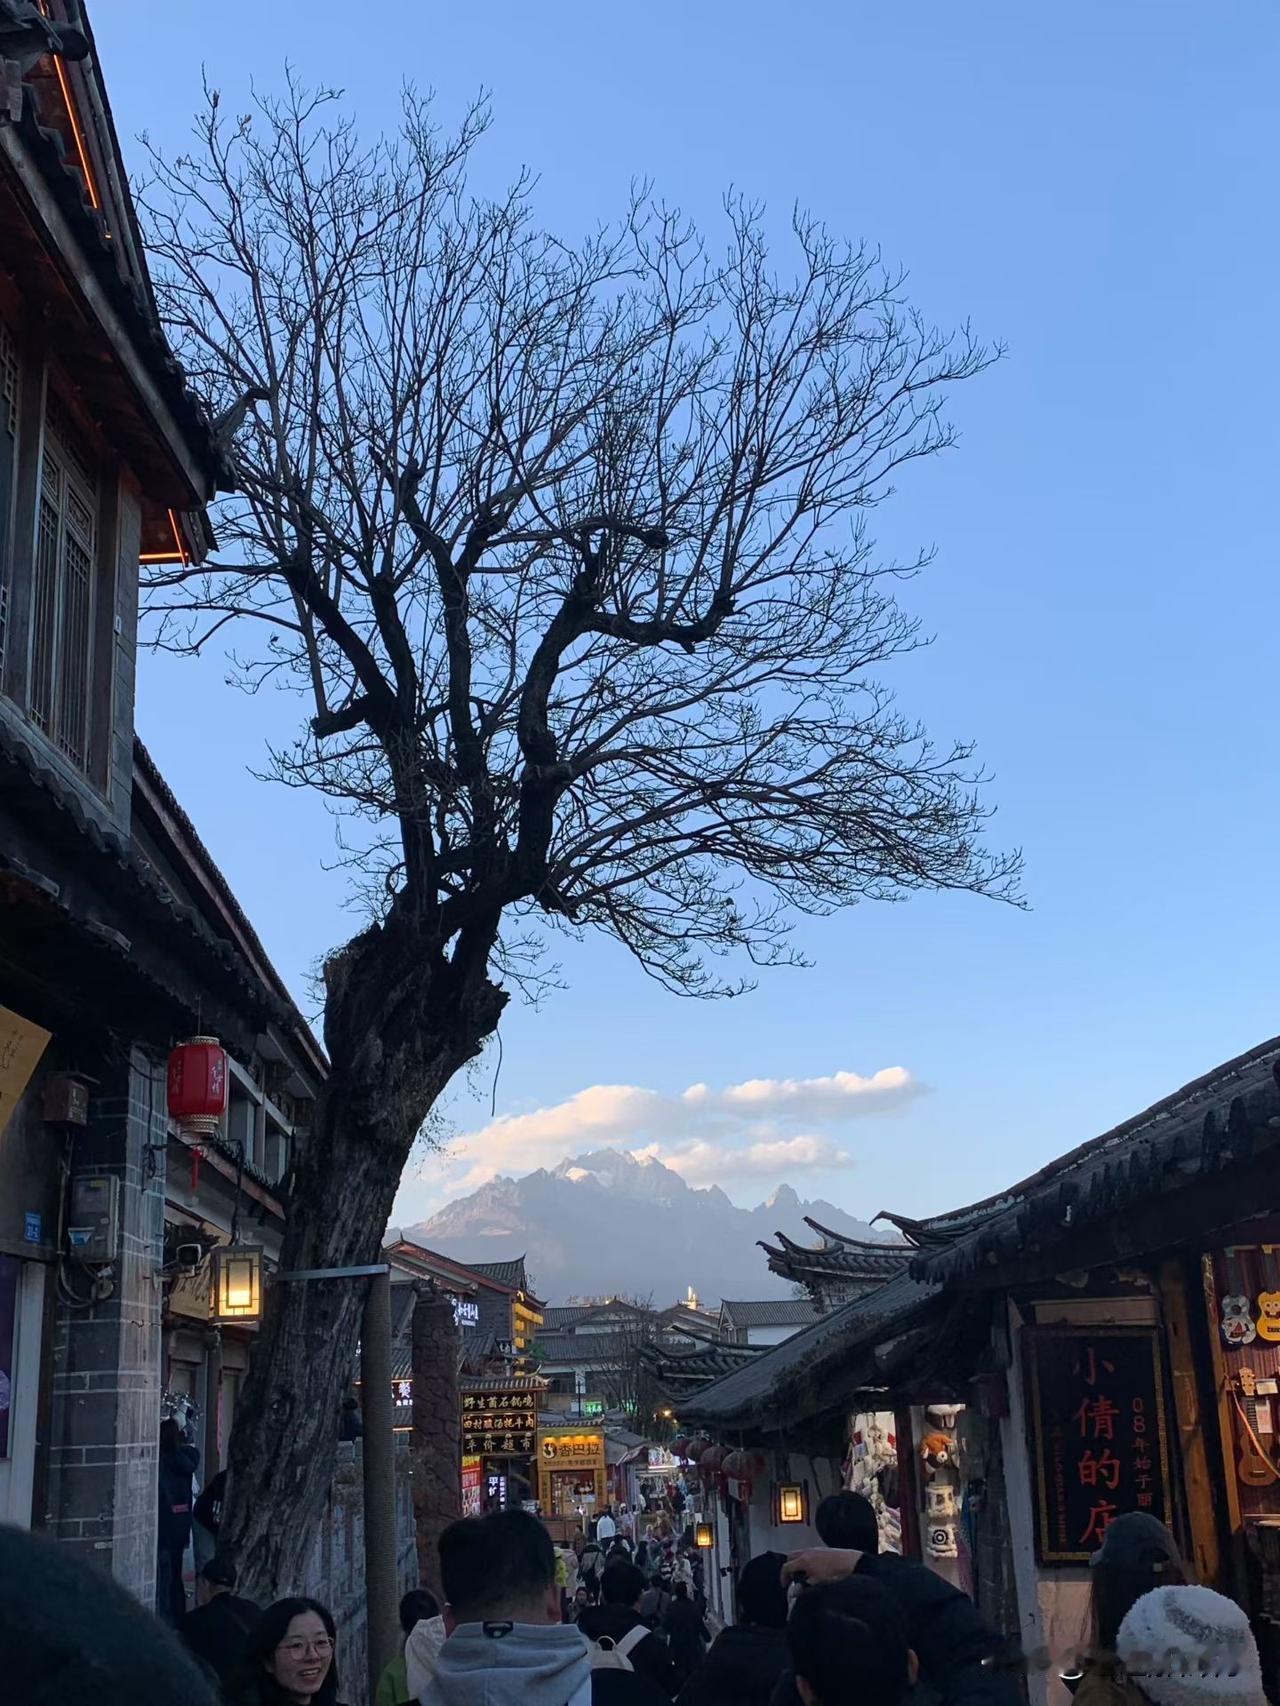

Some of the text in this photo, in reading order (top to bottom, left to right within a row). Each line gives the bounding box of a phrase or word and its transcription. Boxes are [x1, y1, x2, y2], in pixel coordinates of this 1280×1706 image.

[466, 1438, 531, 1453] 平价超市
[559, 1443, 600, 1456] 香巴拉
